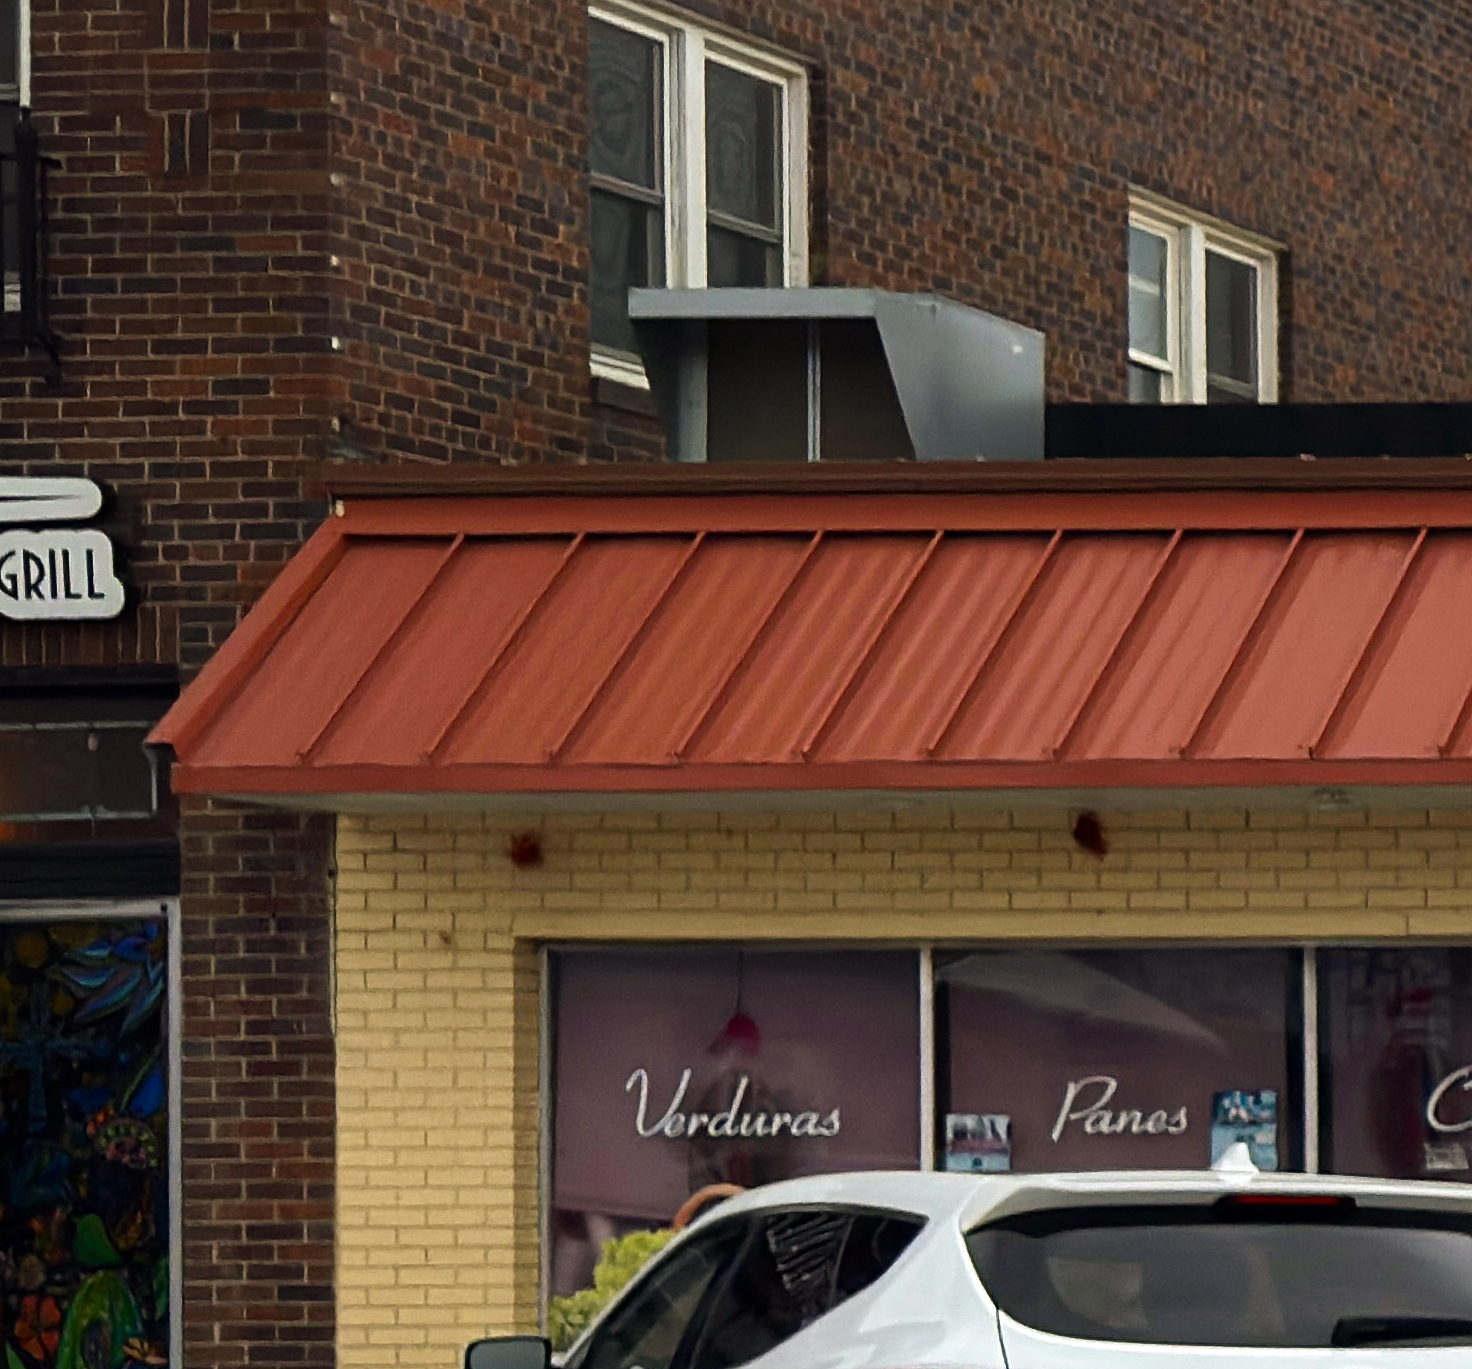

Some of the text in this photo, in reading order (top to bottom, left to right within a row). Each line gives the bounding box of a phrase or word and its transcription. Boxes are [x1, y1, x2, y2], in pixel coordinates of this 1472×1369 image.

[0, 548, 105, 600] GRILL
[626, 1068, 841, 1139] Verduras
[1051, 1076, 1188, 1143] Panes
